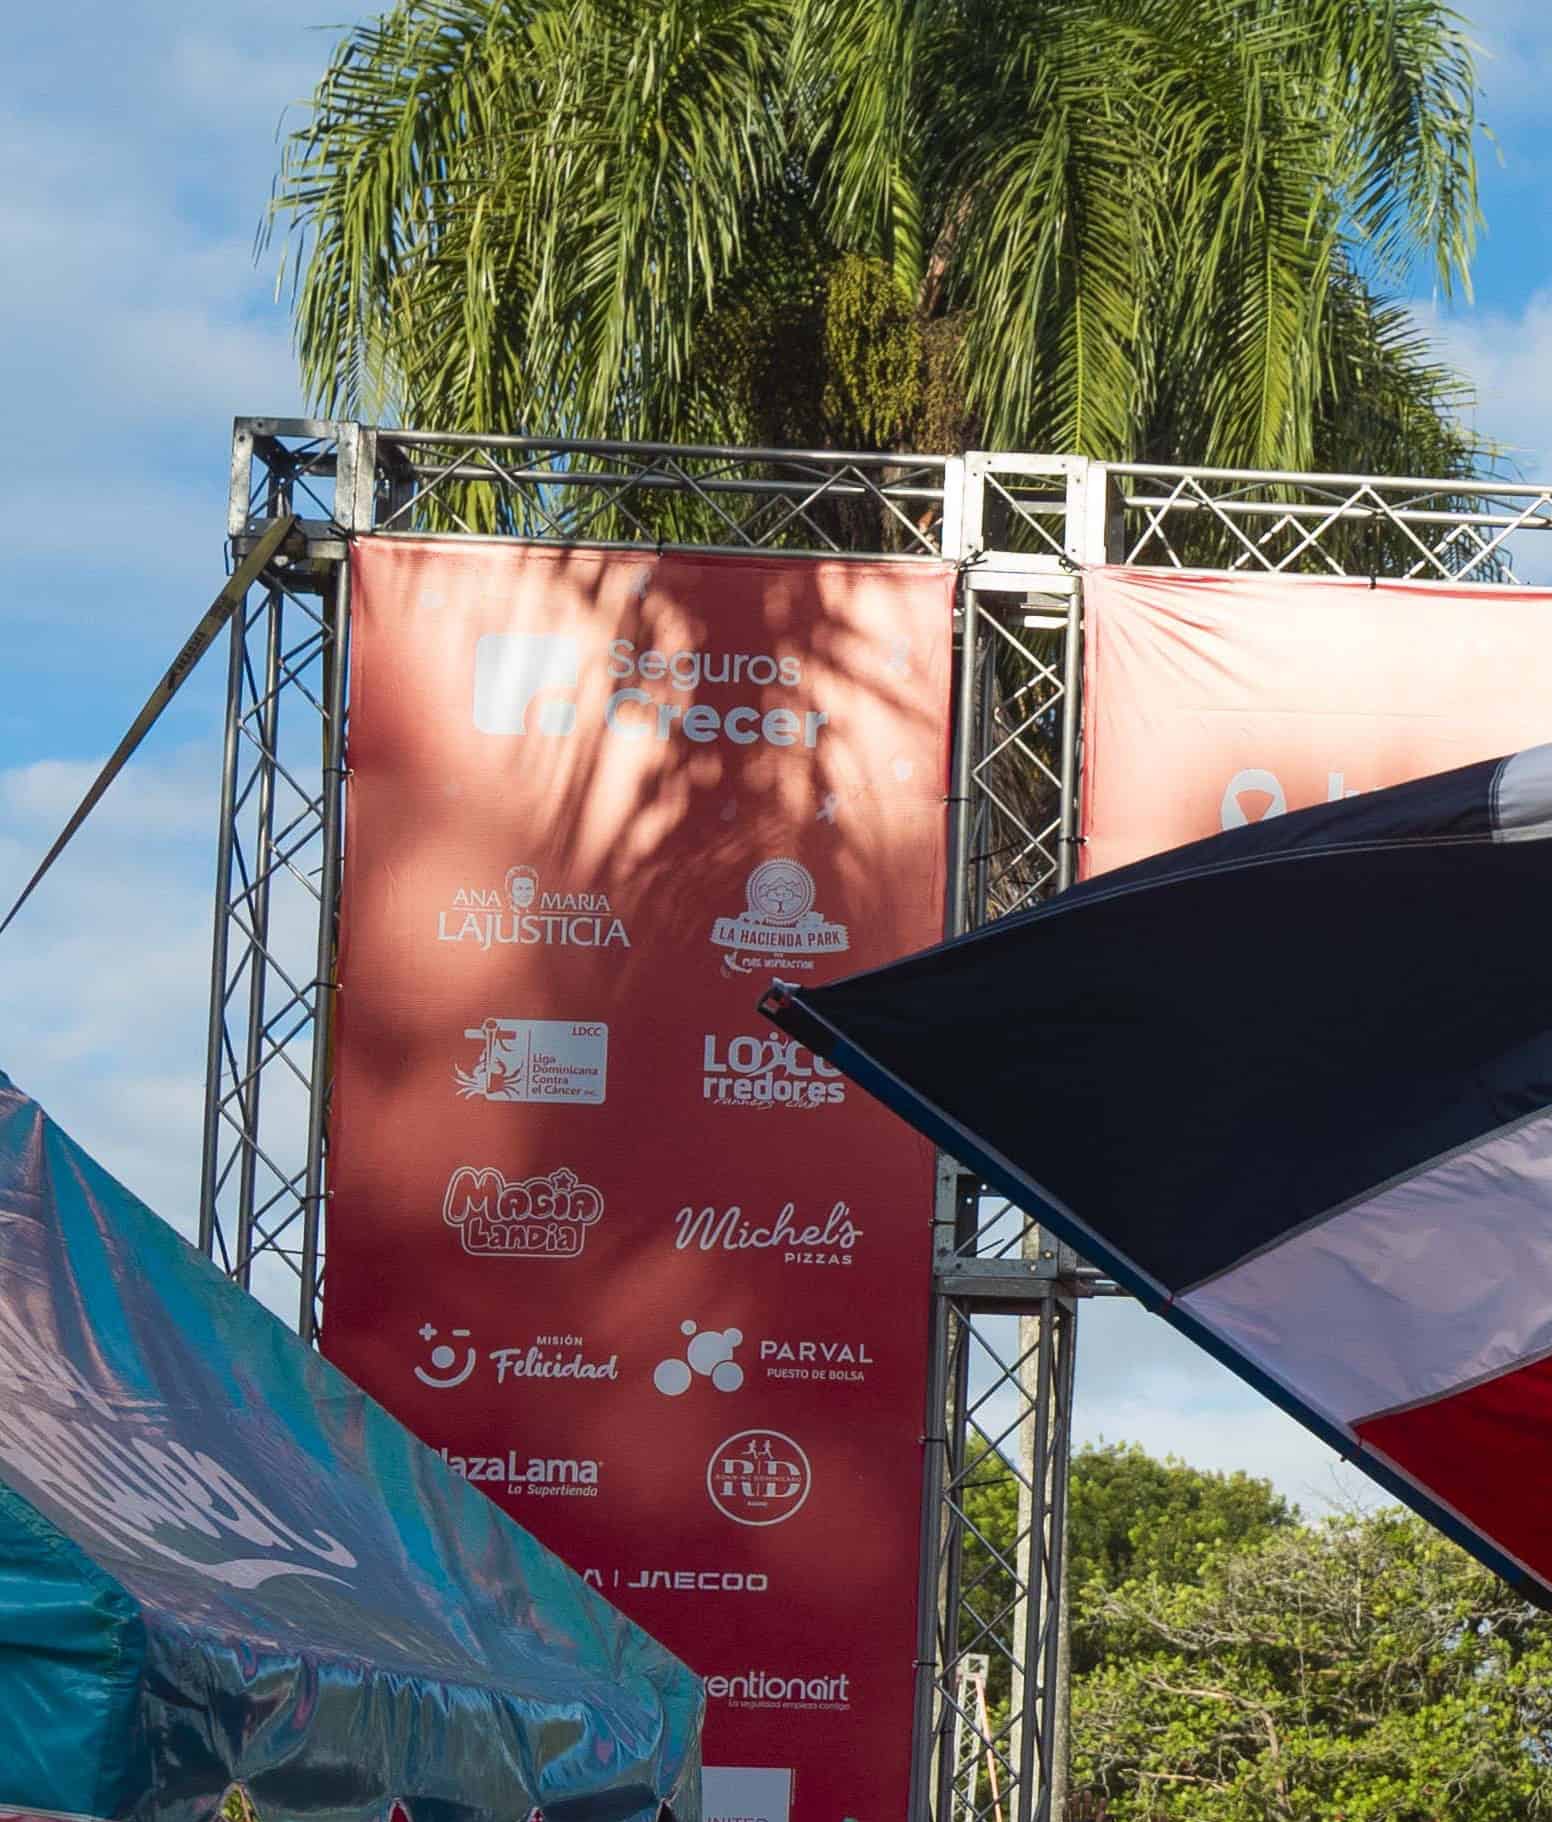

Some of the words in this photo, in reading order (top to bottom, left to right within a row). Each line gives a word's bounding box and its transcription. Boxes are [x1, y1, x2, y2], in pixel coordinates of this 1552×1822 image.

[607, 638, 801, 691] Seguros
[607, 688, 828, 748] Crecer
[453, 889, 500, 907] ANA
[438, 912, 631, 951] LAJUSTICIA
[719, 928, 735, 942] LA
[741, 930, 802, 946] HACIENDA
[808, 931, 840, 945] PARK
[533, 1053, 556, 1067] Liga
[532, 1063, 599, 1077] Dominicana
[532, 1075, 568, 1087] Contra
[532, 1085, 541, 1095] el
[703, 1072, 846, 1104] rredores
[676, 1201, 862, 1250] Michel's
[785, 1253, 852, 1264] PIZZAS
[537, 1334, 583, 1346] MISIÓN
[760, 1340, 873, 1363] PARVAL
[489, 1346, 619, 1384] Felicidad
[767, 1368, 807, 1379] PUESTO
[811, 1369, 825, 1379] DE
[829, 1369, 865, 1381] BOLSA
[508, 1484, 523, 1496] La
[527, 1484, 599, 1498] Supertienda
[627, 1570, 769, 1591] JAECOO
